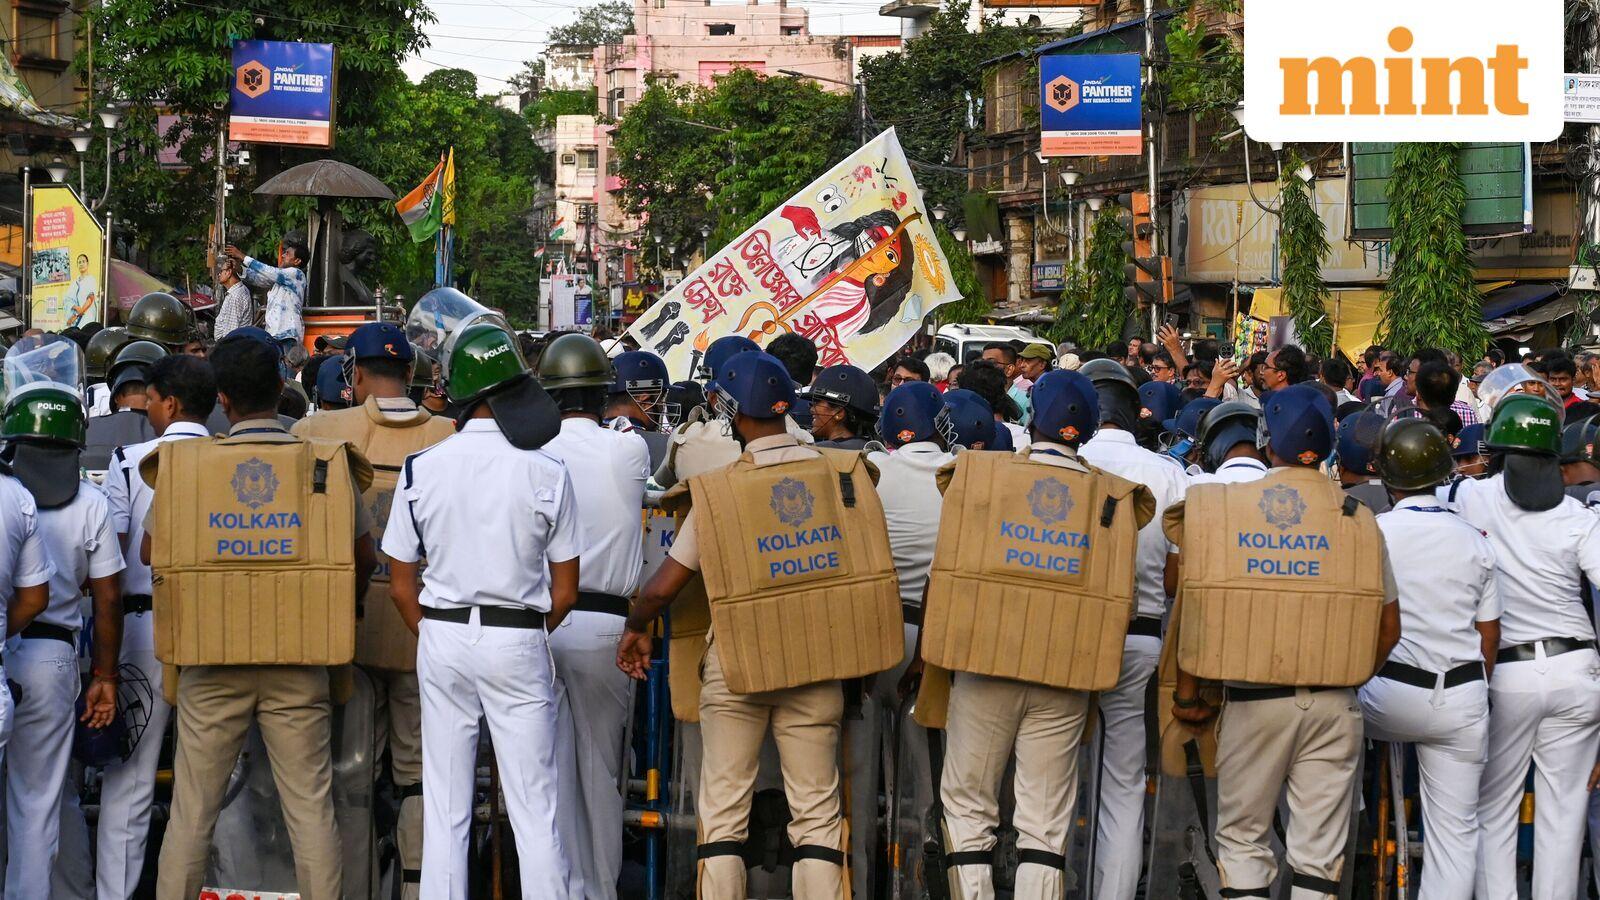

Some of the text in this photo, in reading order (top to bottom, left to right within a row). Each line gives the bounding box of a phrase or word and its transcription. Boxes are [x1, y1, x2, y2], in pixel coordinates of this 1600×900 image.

[273, 73, 324, 87] PANTHER
[1082, 85, 1132, 97] PANTHER
[683, 276, 727, 324] চোখ
[483, 343, 510, 360] POLICE
[37, 402, 67, 412] POLICE
[1525, 416, 1551, 426] POLICE
[208, 512, 302, 529] KOLKATA
[757, 525, 842, 553] KOLKATA
[1000, 520, 1090, 550] KOLKATA
[1238, 532, 1330, 551] KOLKATA
[217, 539, 293, 556] POLICE
[769, 552, 840, 578] POLICE
[1006, 548, 1080, 574] POLICE
[1247, 558, 1320, 576] POLICE
